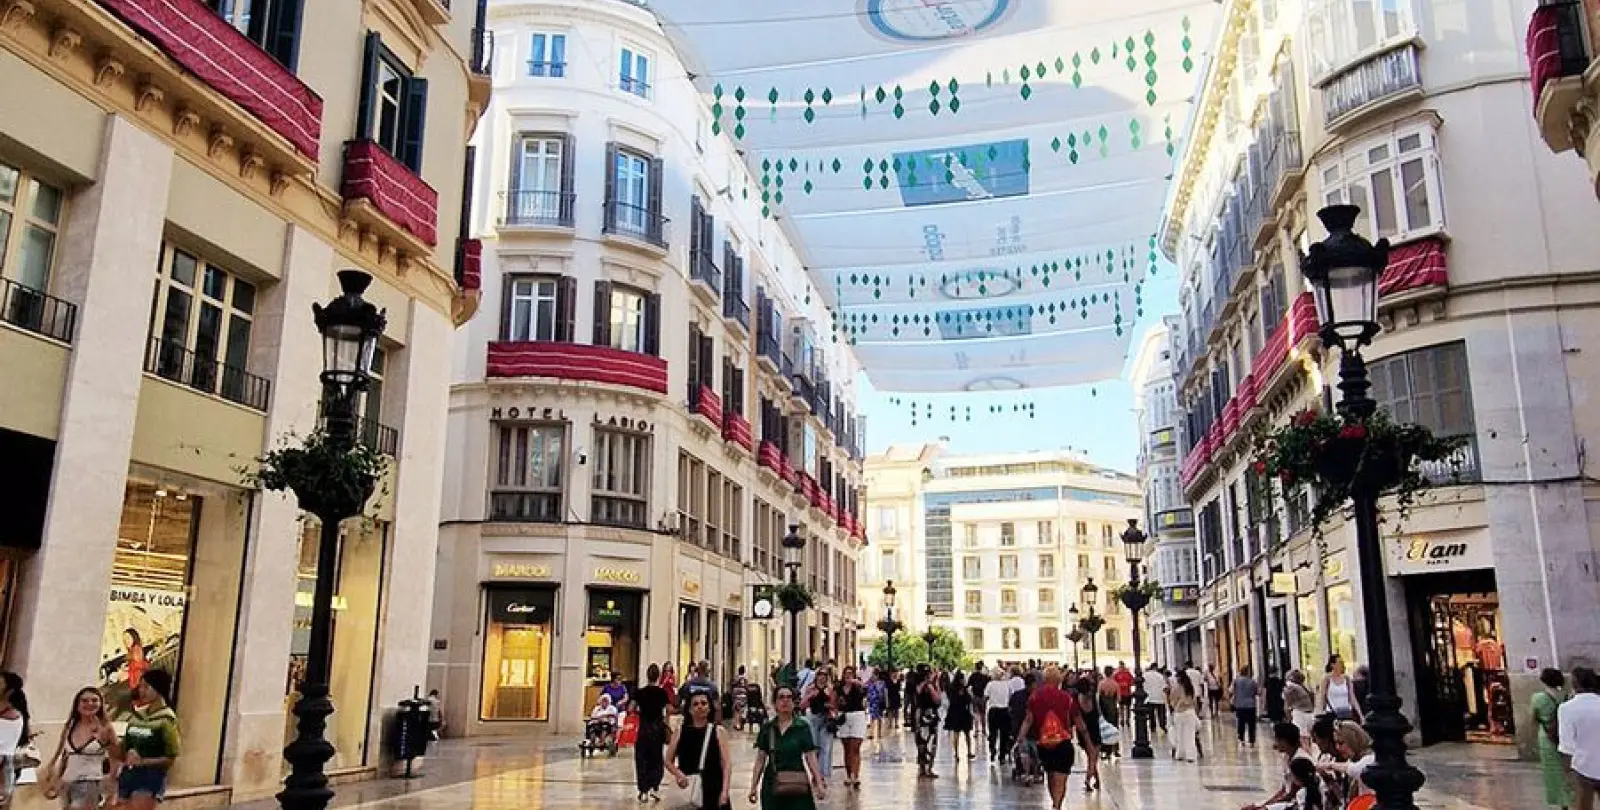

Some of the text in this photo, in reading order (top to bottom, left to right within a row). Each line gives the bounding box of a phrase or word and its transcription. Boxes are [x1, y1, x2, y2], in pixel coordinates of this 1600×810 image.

[491, 406, 568, 420] HOTEL
[110, 590, 184, 606] BIMBA Y LOLA
